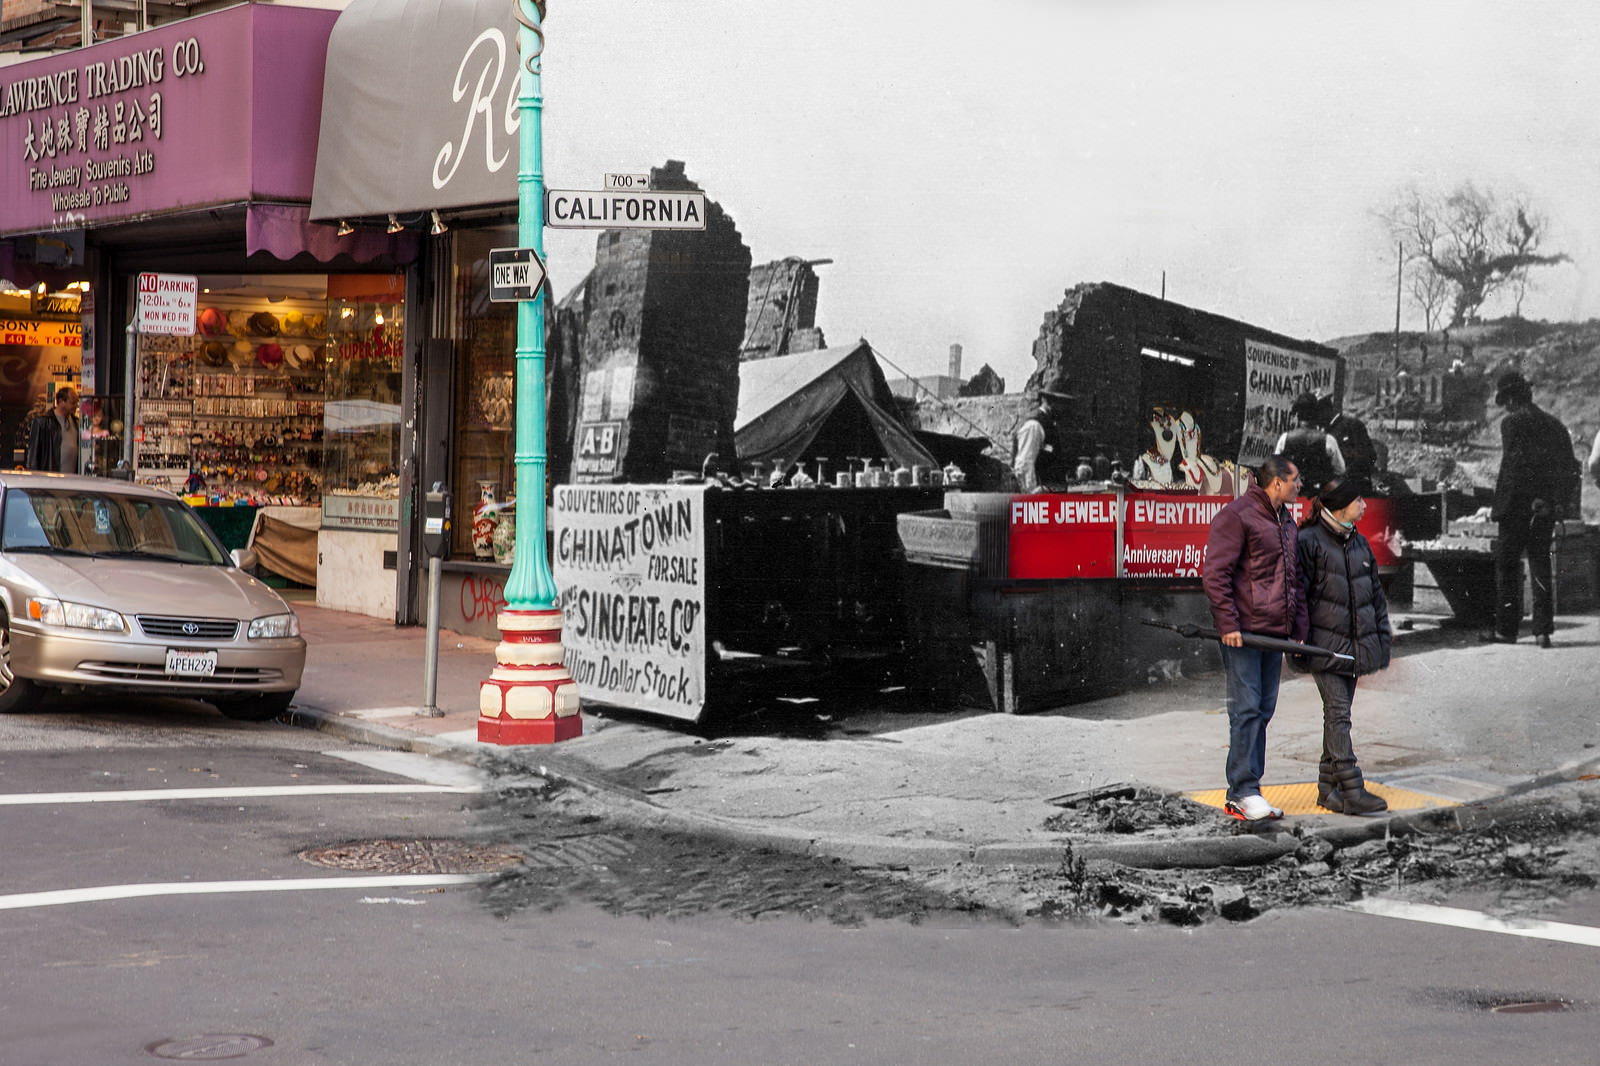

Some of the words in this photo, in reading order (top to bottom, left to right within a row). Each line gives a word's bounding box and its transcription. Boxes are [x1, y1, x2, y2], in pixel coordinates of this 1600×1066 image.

[85, 47, 164, 99] TRADING
[172, 37, 204, 77] CO.
[24, 92, 162, 161] 大地珠寶精品公司
[29, 167, 47, 191] Fine
[49, 165, 81, 189] Jewelry
[86, 154, 131, 181] Souvenirs
[134, 149, 154, 176] Arts
[611, 175, 633, 187] 700
[52, 189, 90, 211] Wholesale
[92, 186, 102, 205] To
[104, 182, 129, 203] Public
[554, 197, 700, 222] CALIFORNIA
[140, 275, 156, 291] NO
[159, 280, 195, 293] PARKING
[495, 266, 510, 284] ONE
[513, 265, 530, 284] WAY
[144, 311, 160, 321] MON
[162, 311, 176, 321] WED
[178, 312, 189, 322] FRI
[338, 340, 372, 361] SUPER
[1247, 346, 1290, 370] SOUVENIRS
[1249, 367, 1332, 397] CHINATOWN
[559, 489, 625, 515] SOUVENIRS
[626, 491, 641, 515] OF
[1012, 501, 1049, 525] FINE
[1134, 499, 1228, 525] EVERYTHIN
[558, 498, 693, 565] CHINATOWN
[1122, 543, 1183, 568] Anniversary
[1184, 544, 1201, 568] Big
[648, 555, 669, 583] FOR
[670, 555, 698, 586] SALE
[576, 588, 626, 644] SING
[628, 595, 660, 646] FAT
[657, 610, 668, 641] &
[169, 657, 214, 673] 4PEH293
[563, 647, 597, 685] illion
[598, 655, 642, 694] Dollar
[641, 660, 693, 706] Stock.
